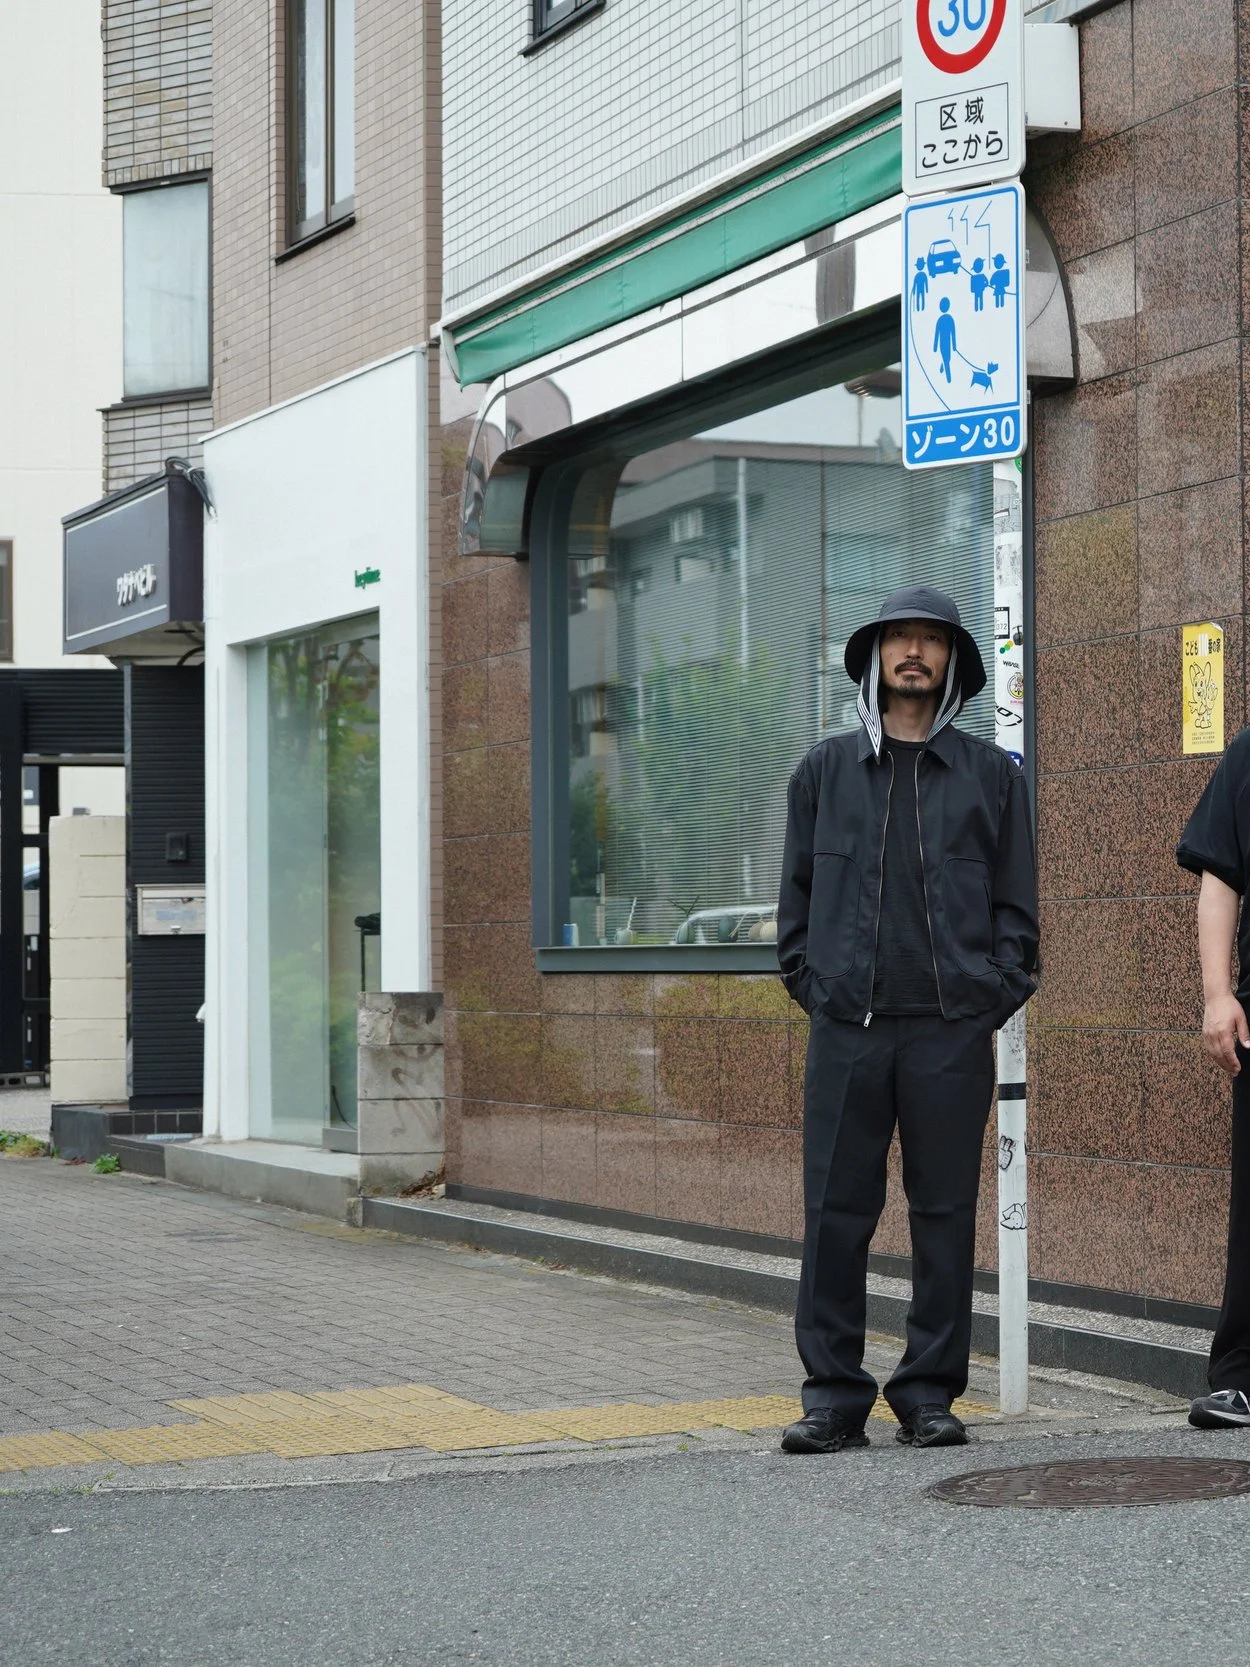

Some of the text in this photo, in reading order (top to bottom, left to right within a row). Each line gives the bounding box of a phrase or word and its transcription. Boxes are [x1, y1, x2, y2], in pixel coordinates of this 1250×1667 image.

[940, 96, 985, 131] 区域
[922, 131, 1003, 168] ここから
[912, 415, 1015, 459] ゾーン30
